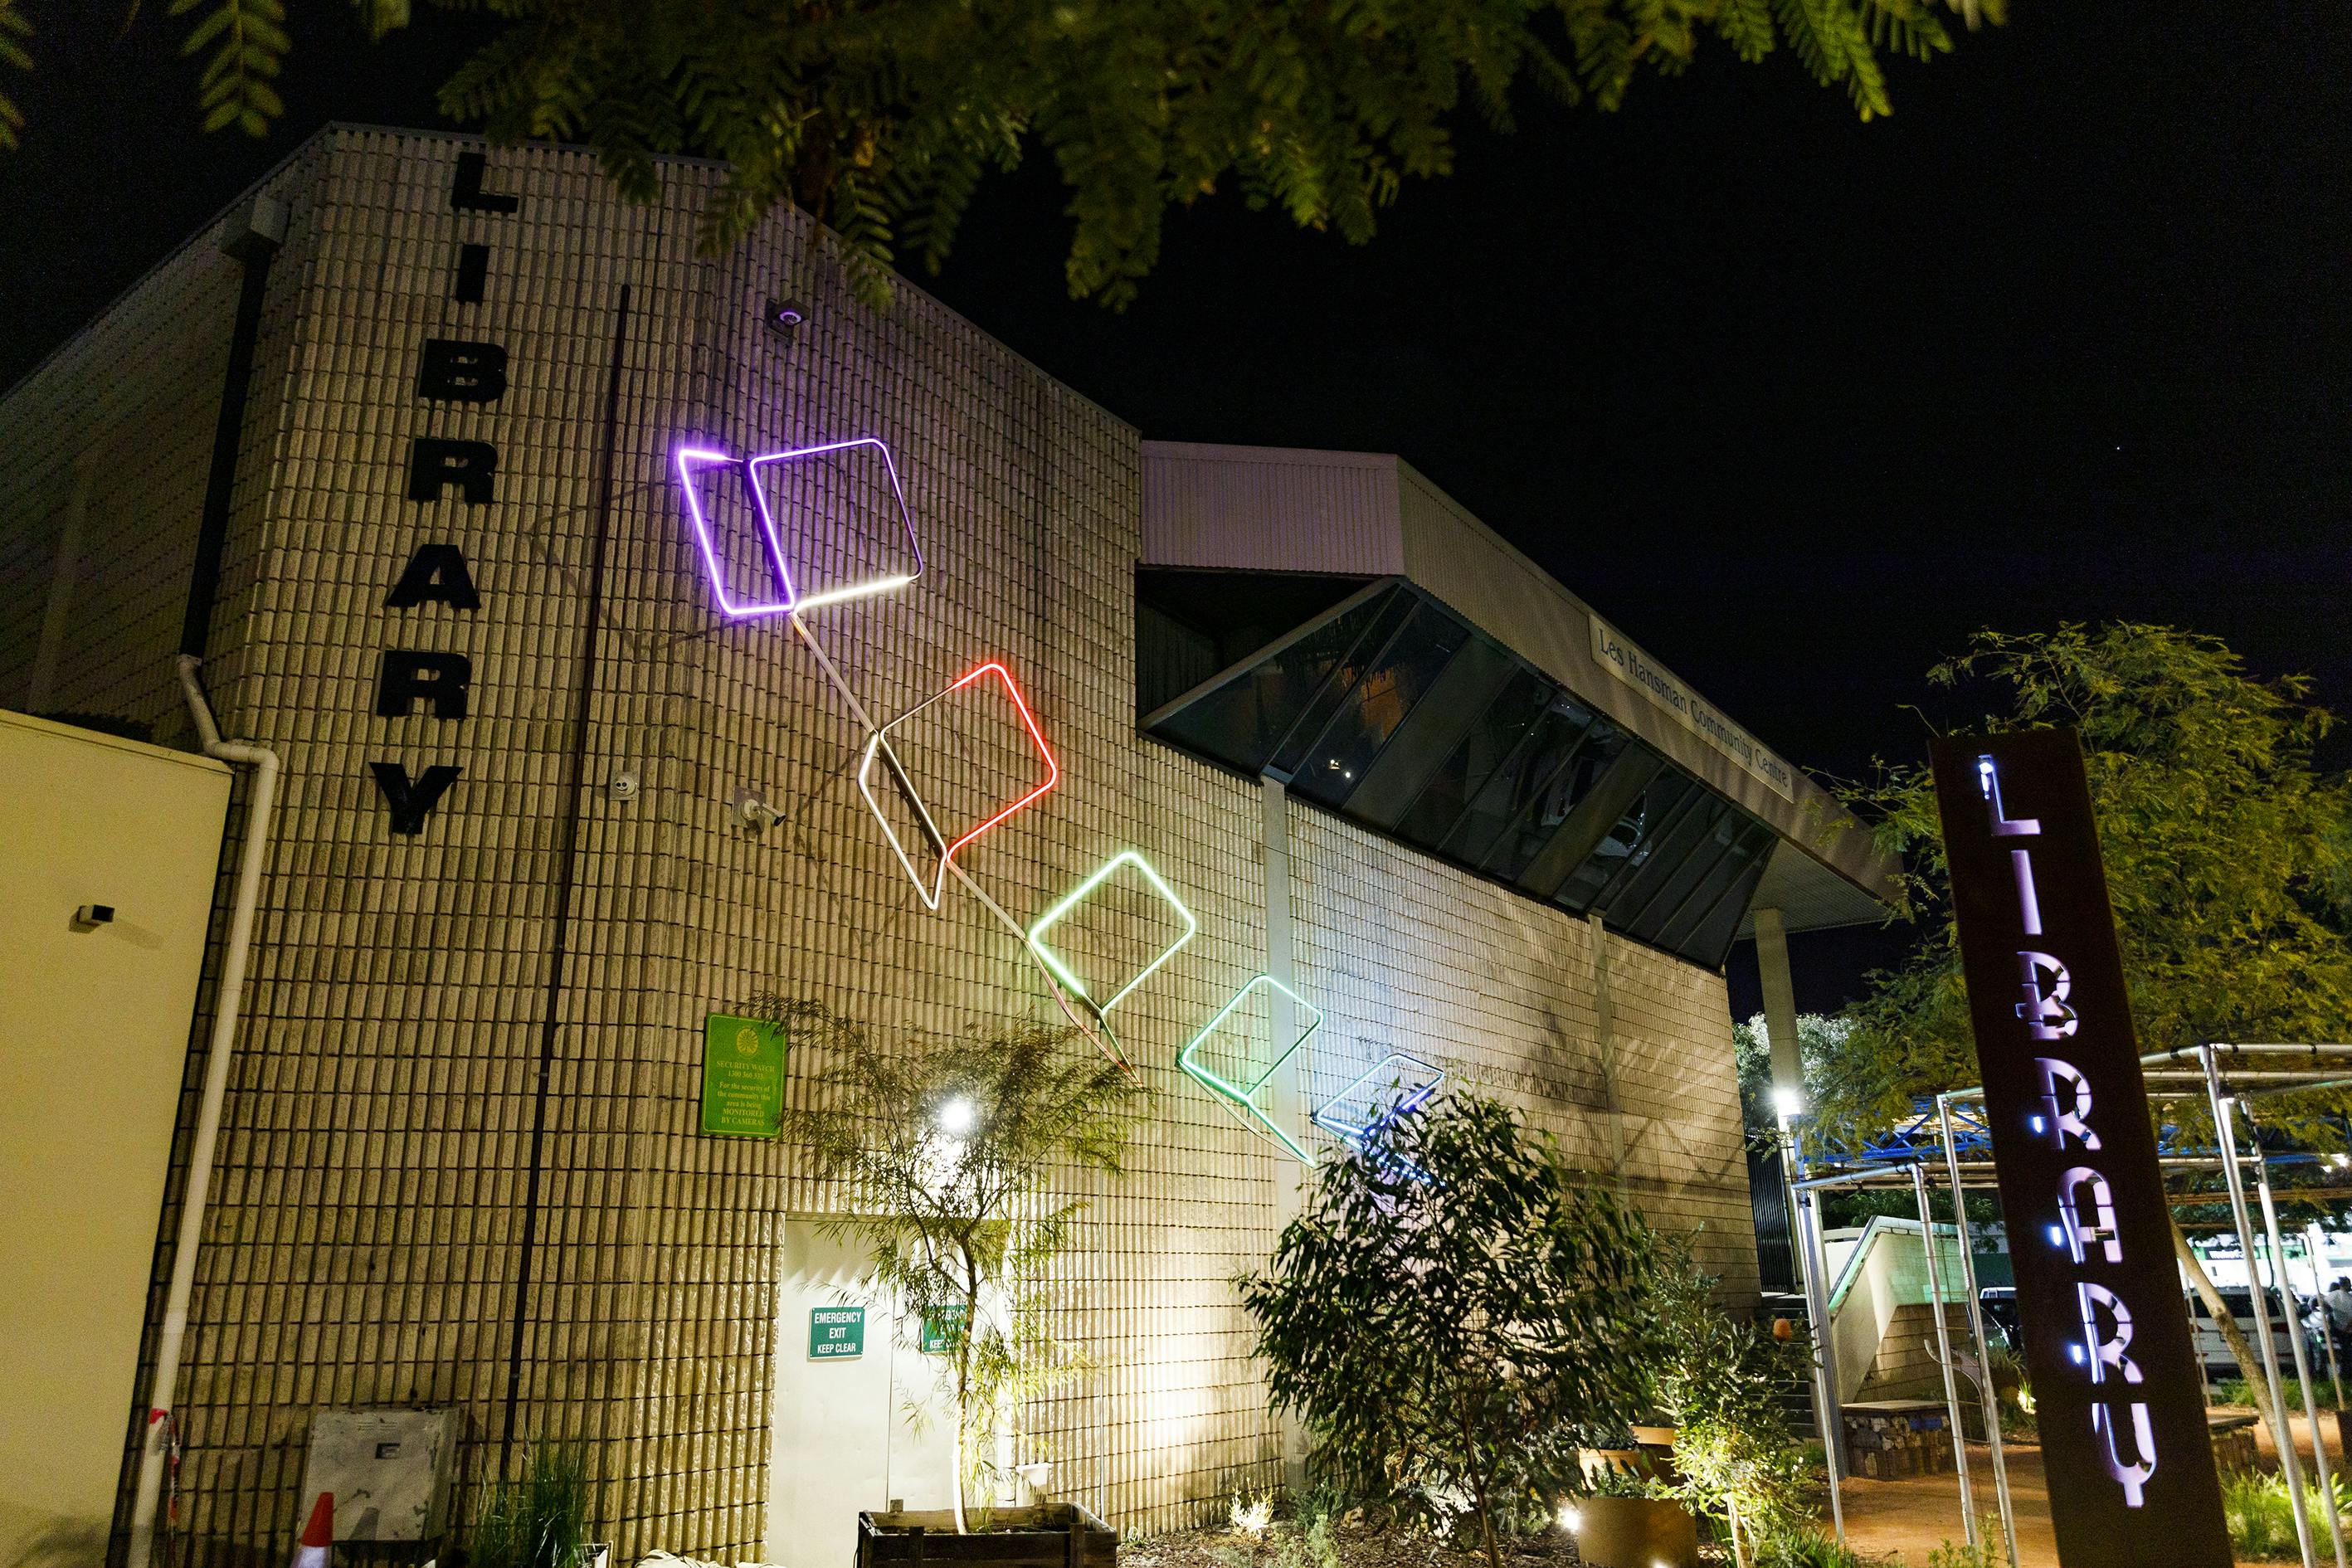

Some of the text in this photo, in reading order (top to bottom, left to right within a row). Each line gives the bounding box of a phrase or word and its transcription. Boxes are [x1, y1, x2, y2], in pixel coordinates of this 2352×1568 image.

[369, 152, 519, 835] LIBRARY
[1599, 628, 1788, 788] Les Hansman Community Centre
[716, 1060, 775, 1072] SECURITY WATCH
[741, 1084, 762, 1093] security
[728, 1091, 759, 1100] community
[746, 1101, 762, 1110] being
[723, 1108, 765, 1118] MONITORED
[732, 1118, 765, 1127] CAMERAS
[1978, 754, 2157, 1508] LIBRARY
[814, 1311, 862, 1324] EMERGENCY
[829, 1327, 846, 1339] EXIT
[817, 1342, 856, 1354] KEEP CLEAR
